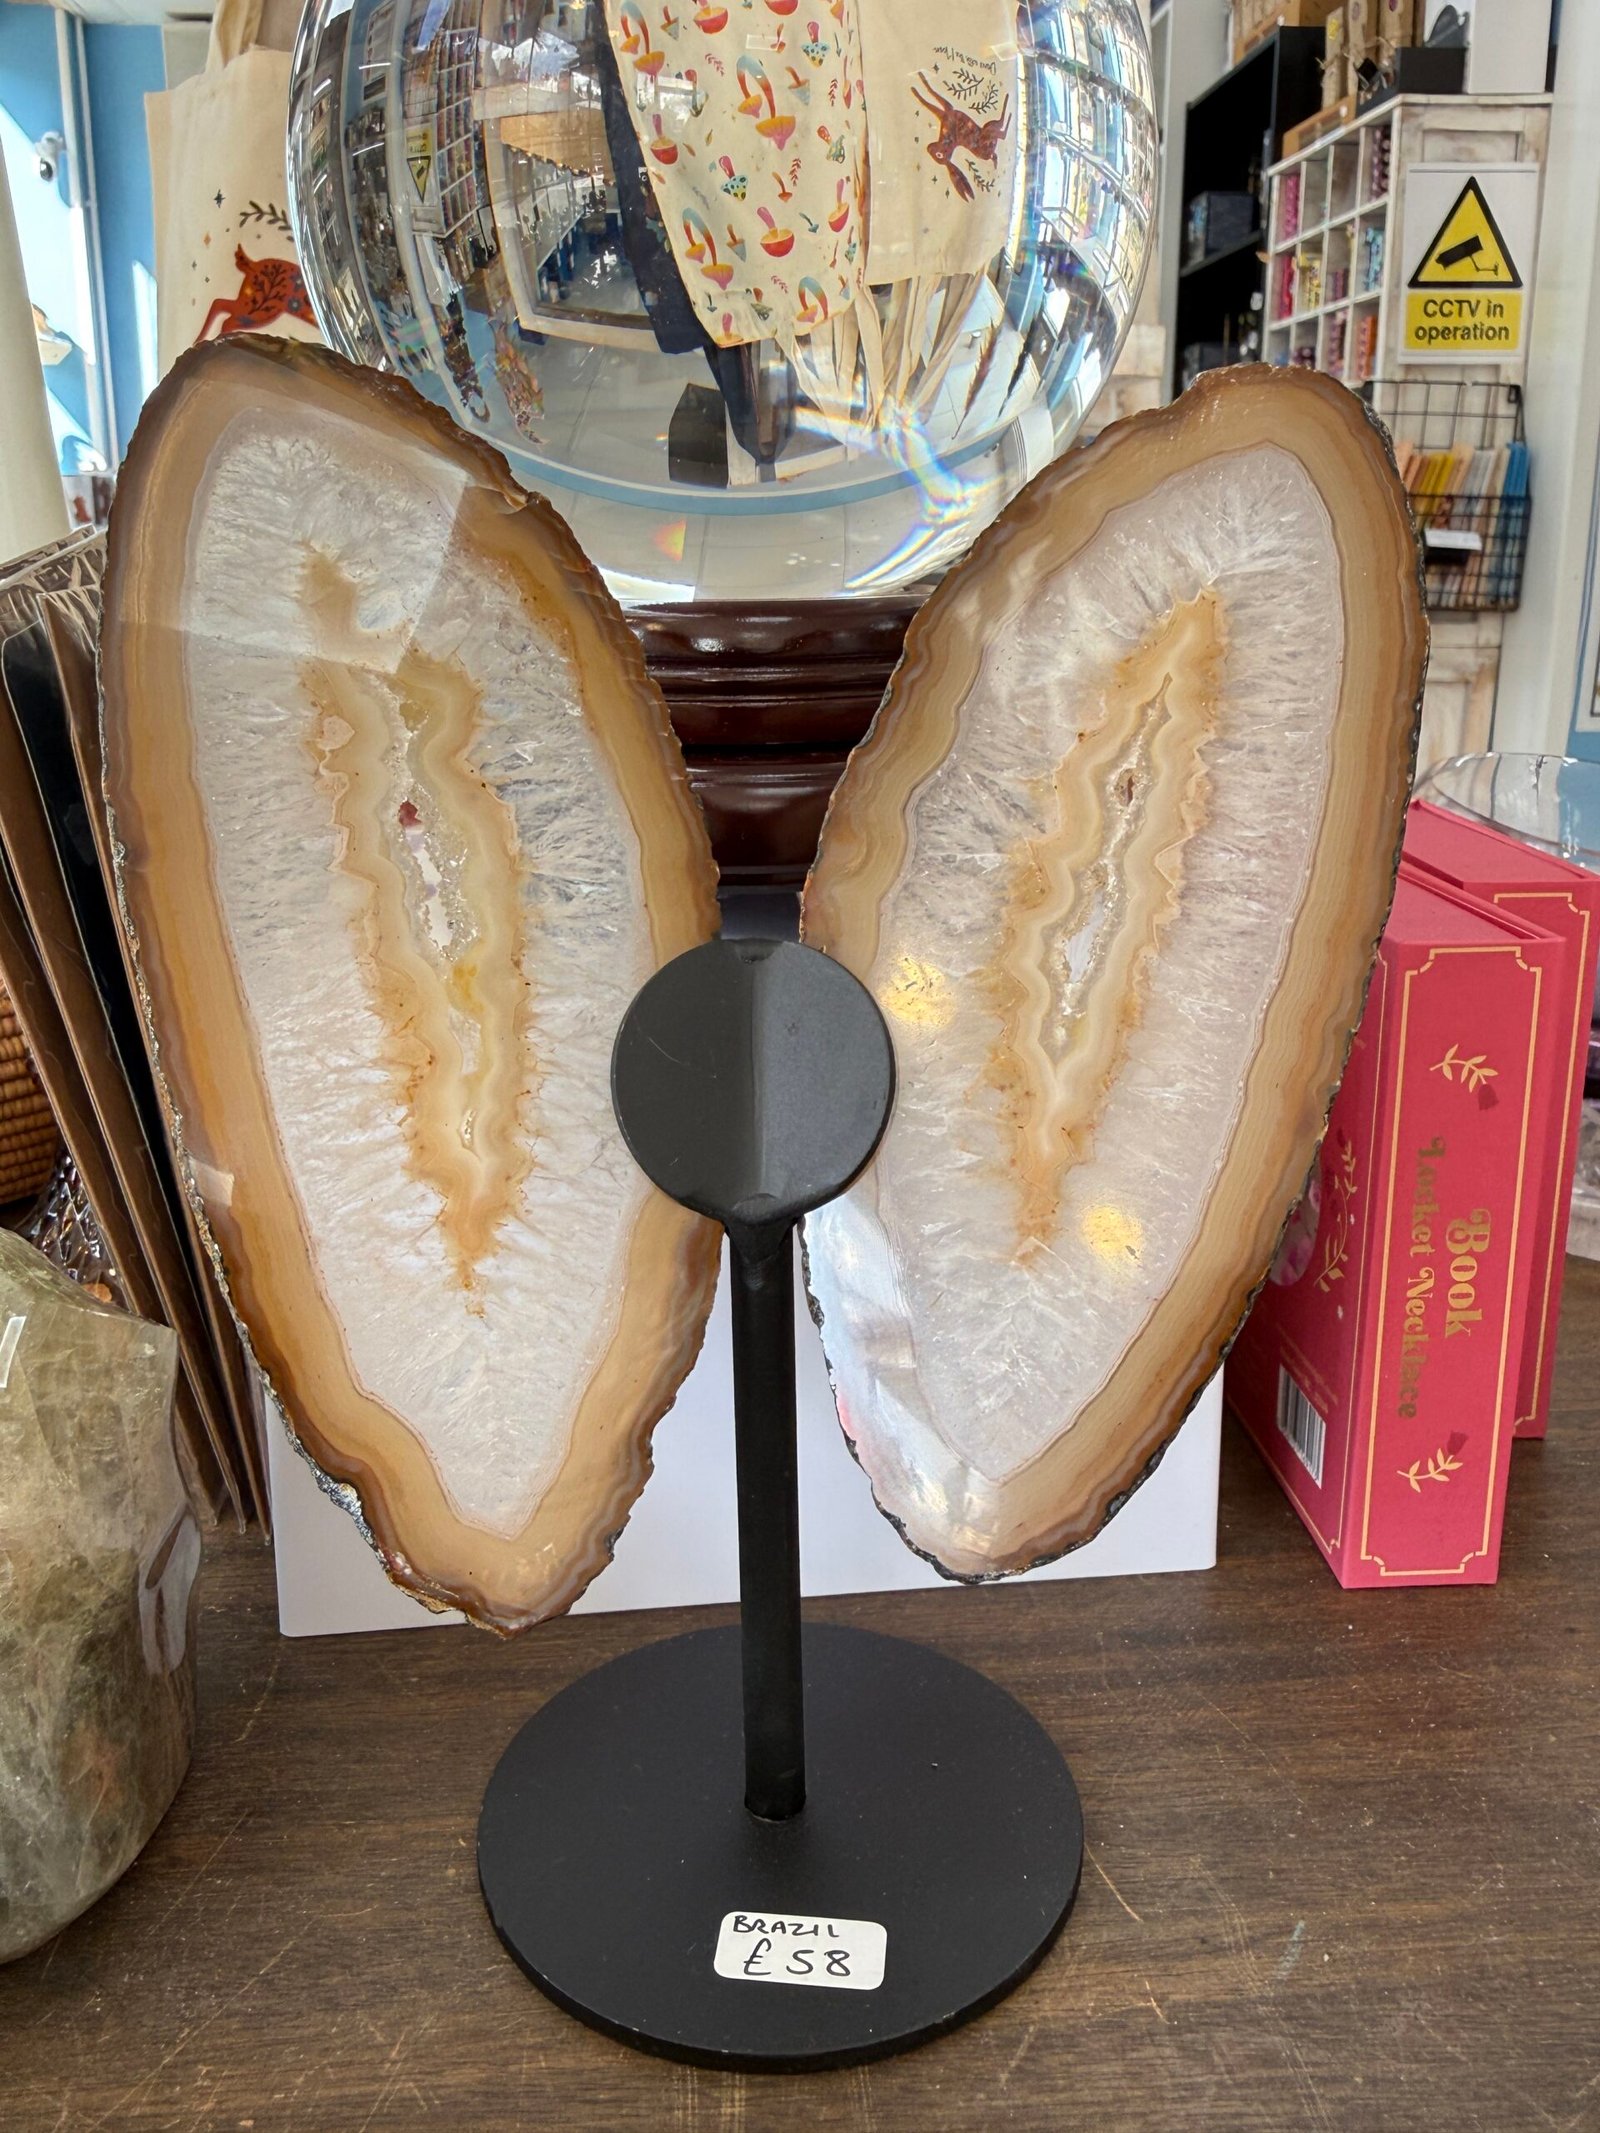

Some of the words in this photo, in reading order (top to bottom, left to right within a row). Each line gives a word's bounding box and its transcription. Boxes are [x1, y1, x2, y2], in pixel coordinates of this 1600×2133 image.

[1414, 321, 1510, 345] operation
[1423, 299, 1480, 318] CCTV
[1486, 299, 1504, 318] in
[1409, 1135, 1446, 1257] Locket
[1445, 1208, 1491, 1338] Book
[1398, 1267, 1435, 1418] Necklace
[732, 1914, 839, 1938] BRAZIL
